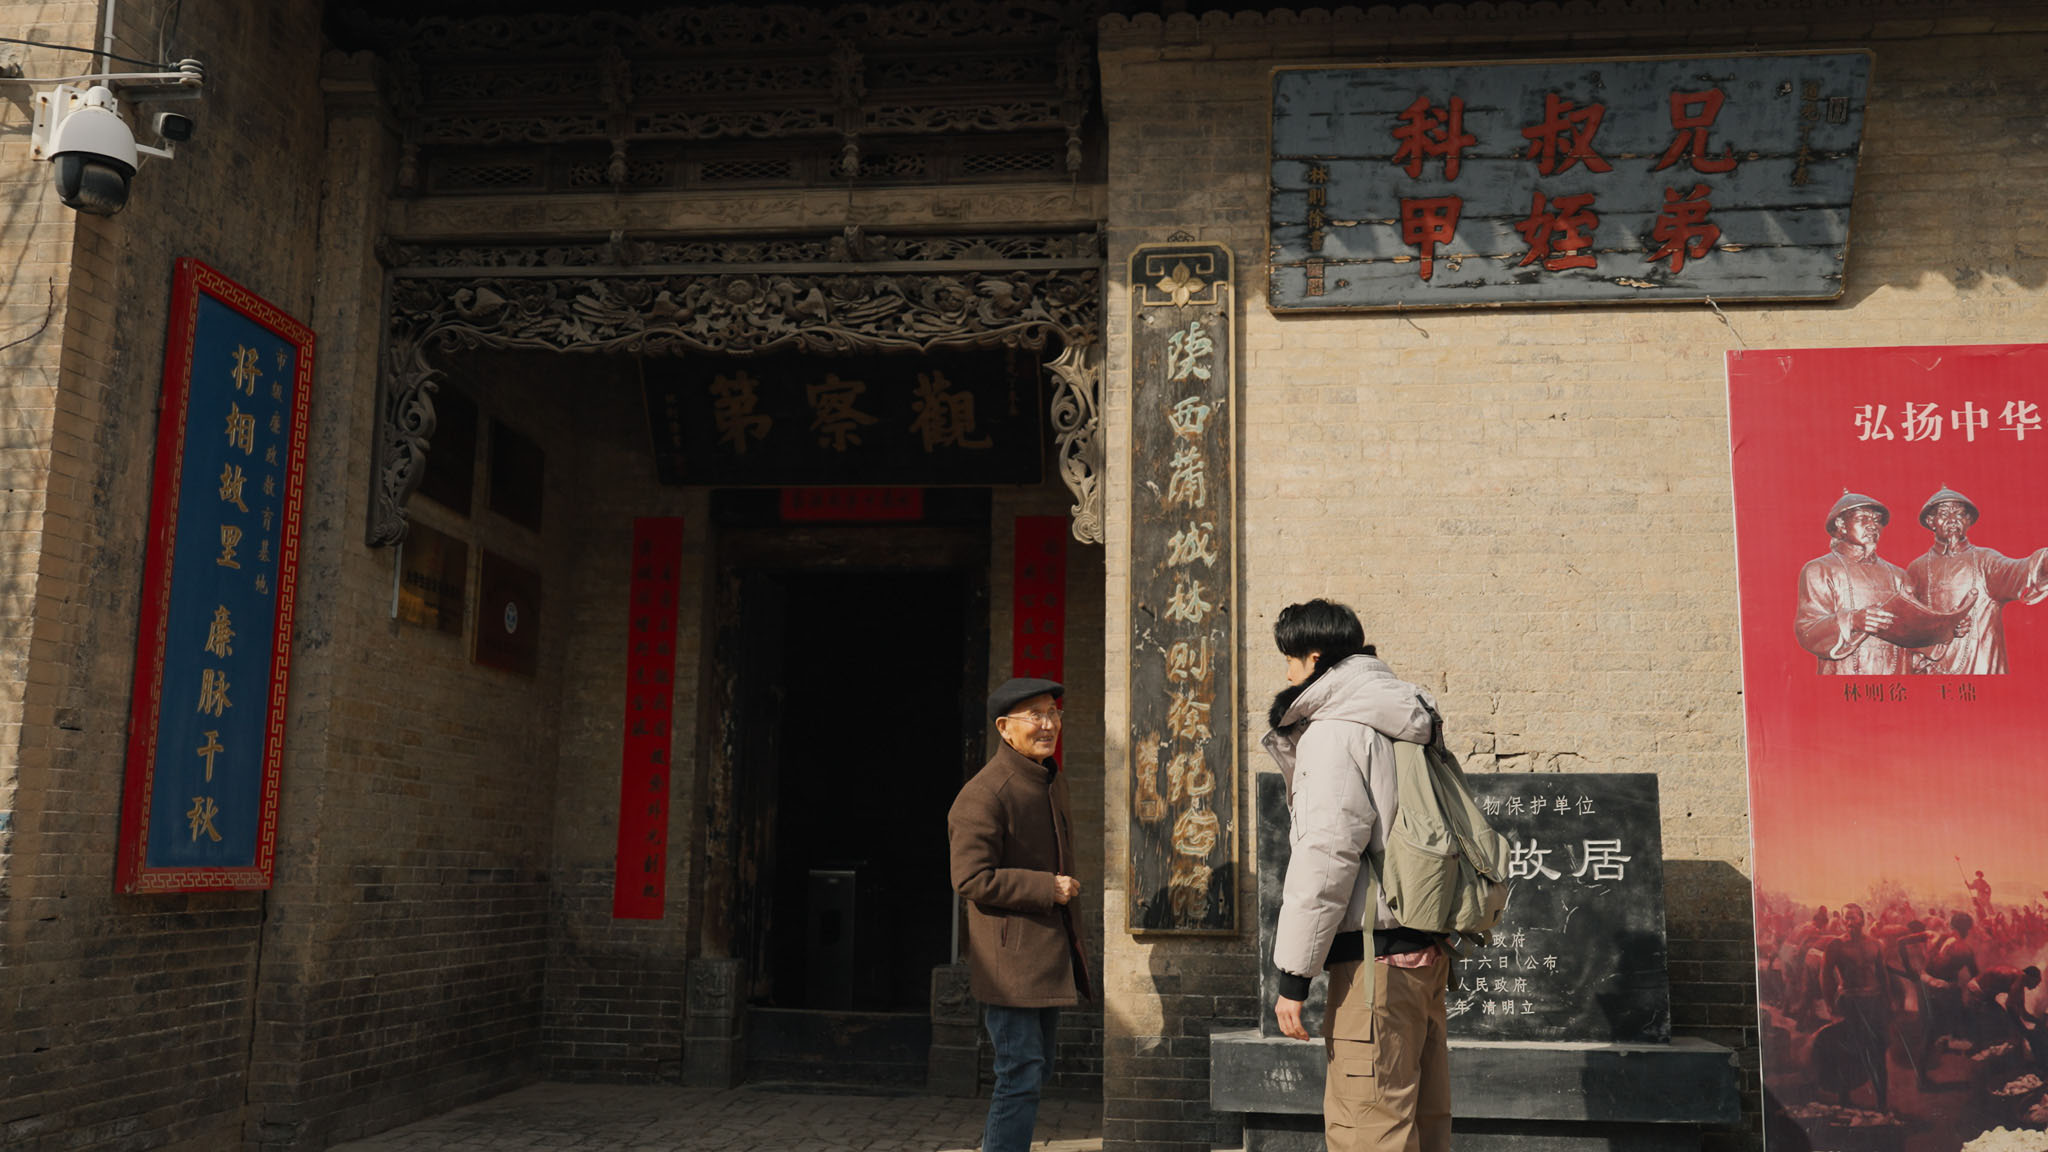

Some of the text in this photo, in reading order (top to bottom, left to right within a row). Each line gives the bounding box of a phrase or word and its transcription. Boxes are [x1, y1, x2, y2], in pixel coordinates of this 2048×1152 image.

[1391, 94, 1477, 281] 科甲
[1647, 87, 1738, 274] 兄弟
[1853, 400, 2043, 442] 弘扬中华
[1474, 794, 1596, 816] 物保护单位
[1446, 977, 1528, 993] 人民政府
